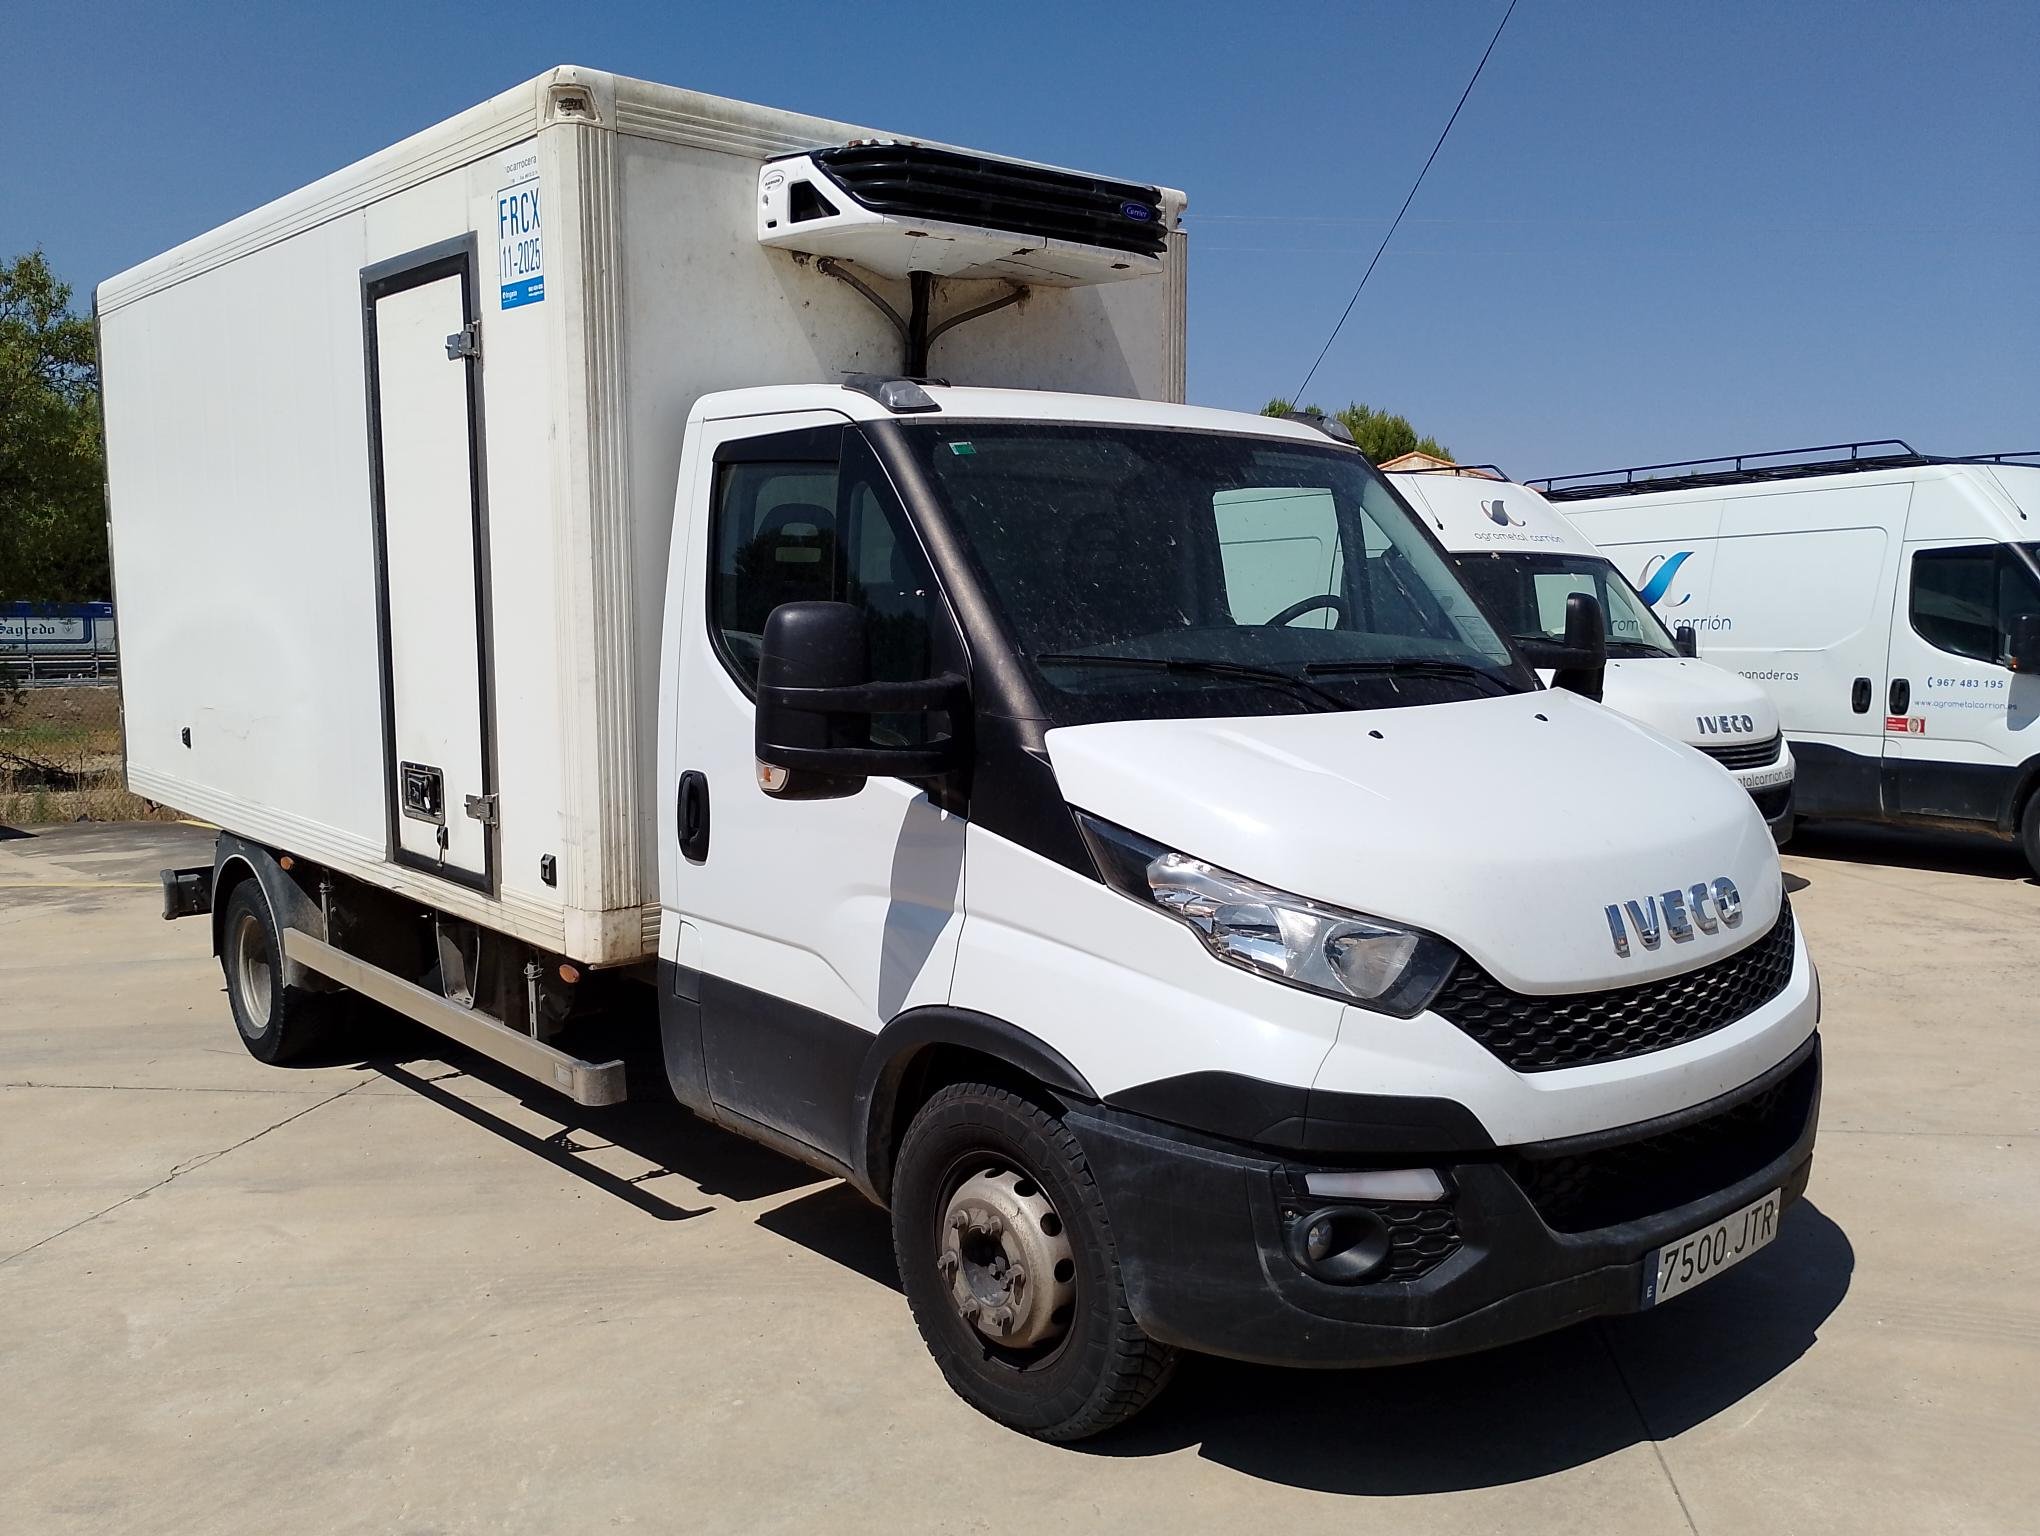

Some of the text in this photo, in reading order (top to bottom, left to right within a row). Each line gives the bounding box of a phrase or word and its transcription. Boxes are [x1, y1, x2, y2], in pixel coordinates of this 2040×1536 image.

[500, 187, 541, 239] FRCX
[502, 237, 541, 279] 11-2025
[1474, 531, 1528, 542] agrometal
[1936, 678, 2004, 689] 967 483 195
[1696, 714, 1754, 735] IVECO
[1604, 876, 1744, 959] IVECO
[1662, 1226, 1727, 1293] 7500
[1734, 1200, 1774, 1253] JTR
